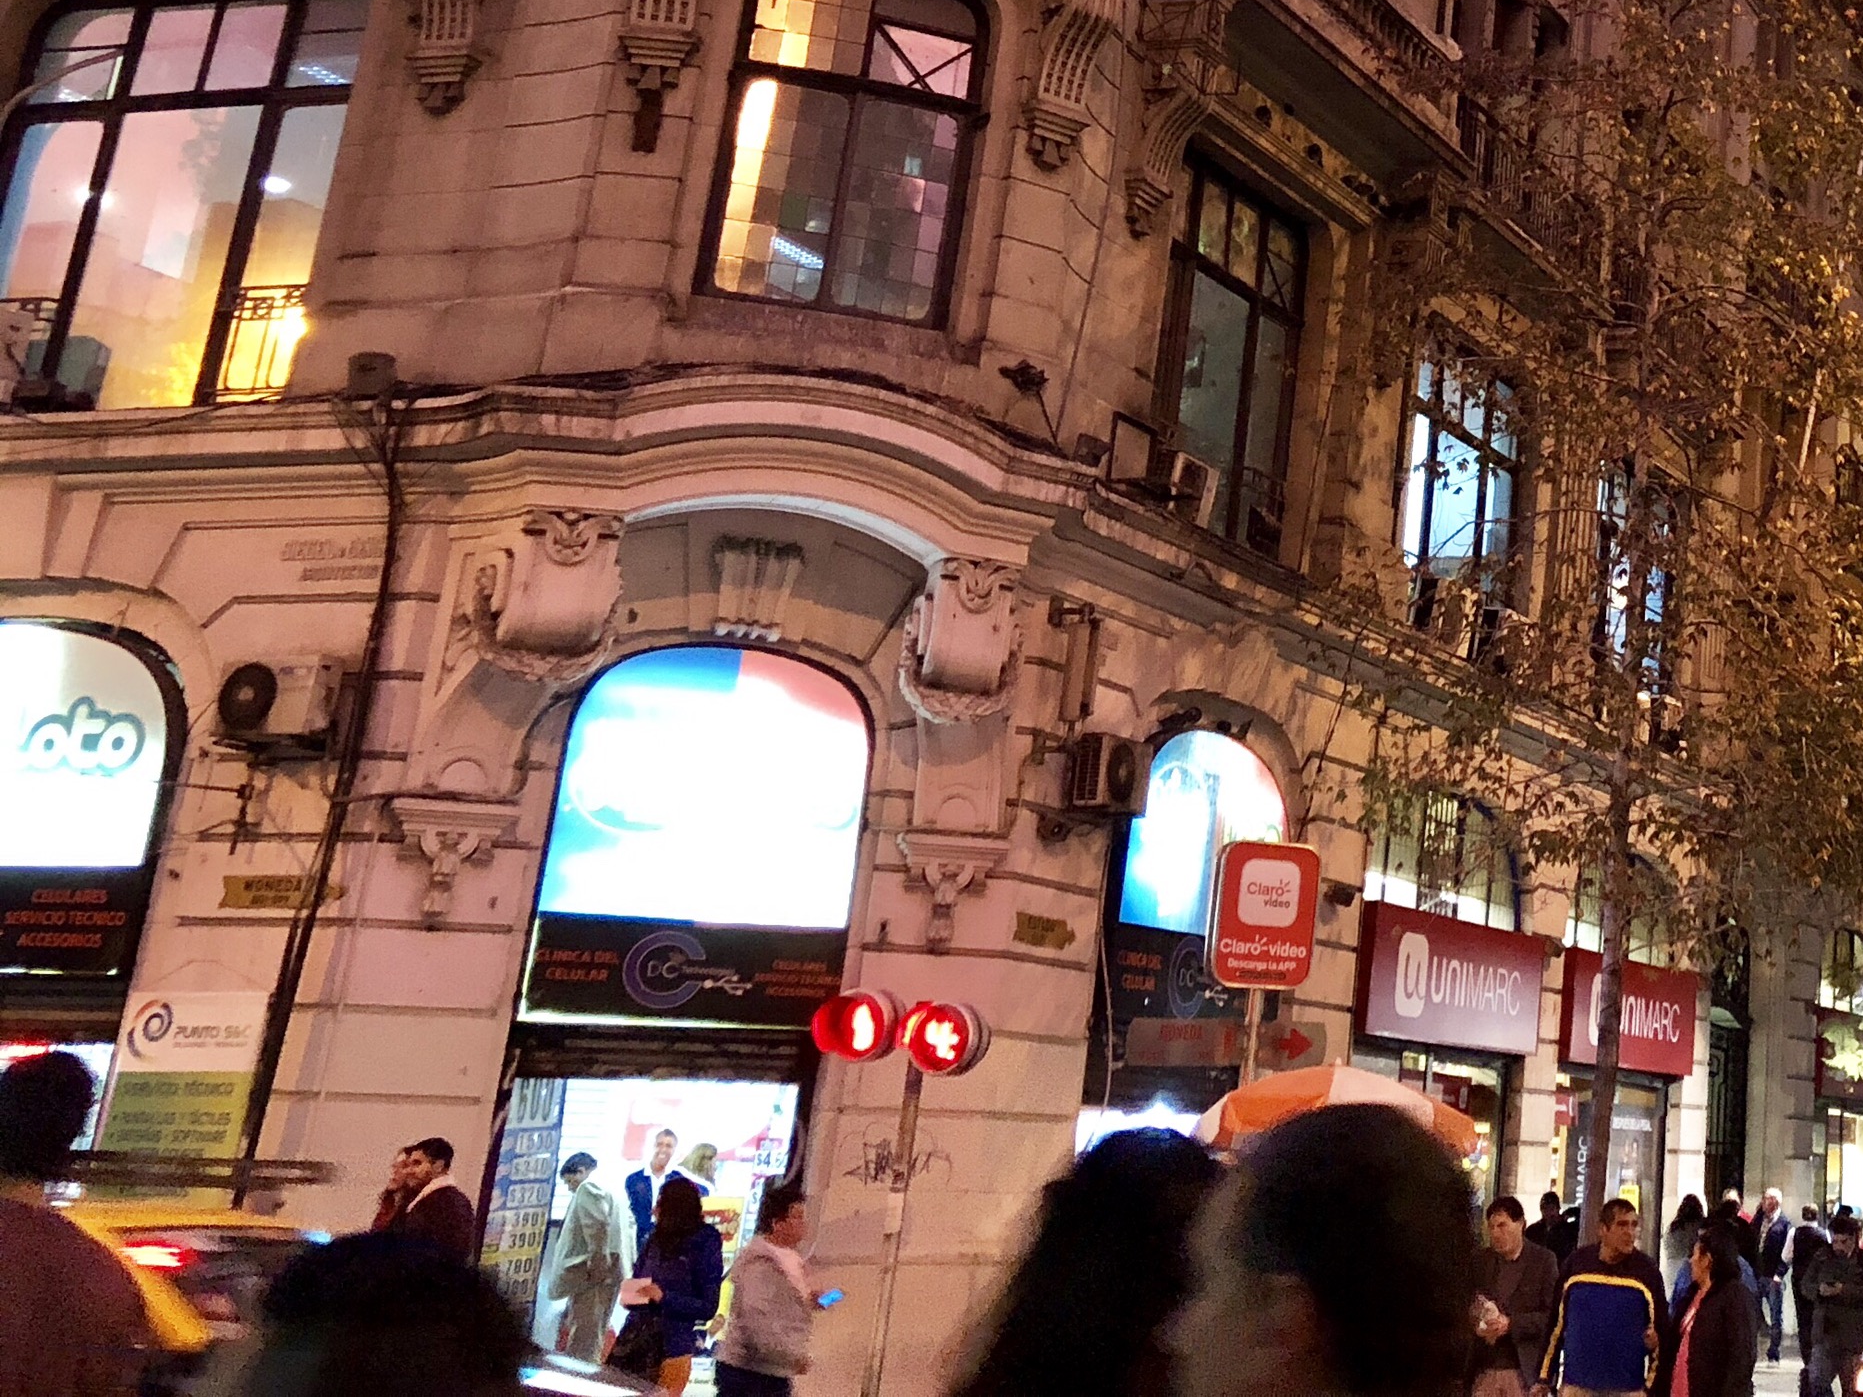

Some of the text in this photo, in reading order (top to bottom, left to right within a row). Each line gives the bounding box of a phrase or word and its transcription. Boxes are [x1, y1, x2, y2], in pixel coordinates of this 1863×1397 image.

[1247, 881, 1285, 896] Claro
[1263, 898, 1290, 908] video
[5, 911, 66, 925] SERVICIO
[16, 933, 102, 947] ACCESORIOS
[1220, 937, 1307, 958] Claro video
[1227, 958, 1266, 971] Descarga
[1278, 960, 1297, 971] APP
[546, 967, 609, 982] CELULAR
